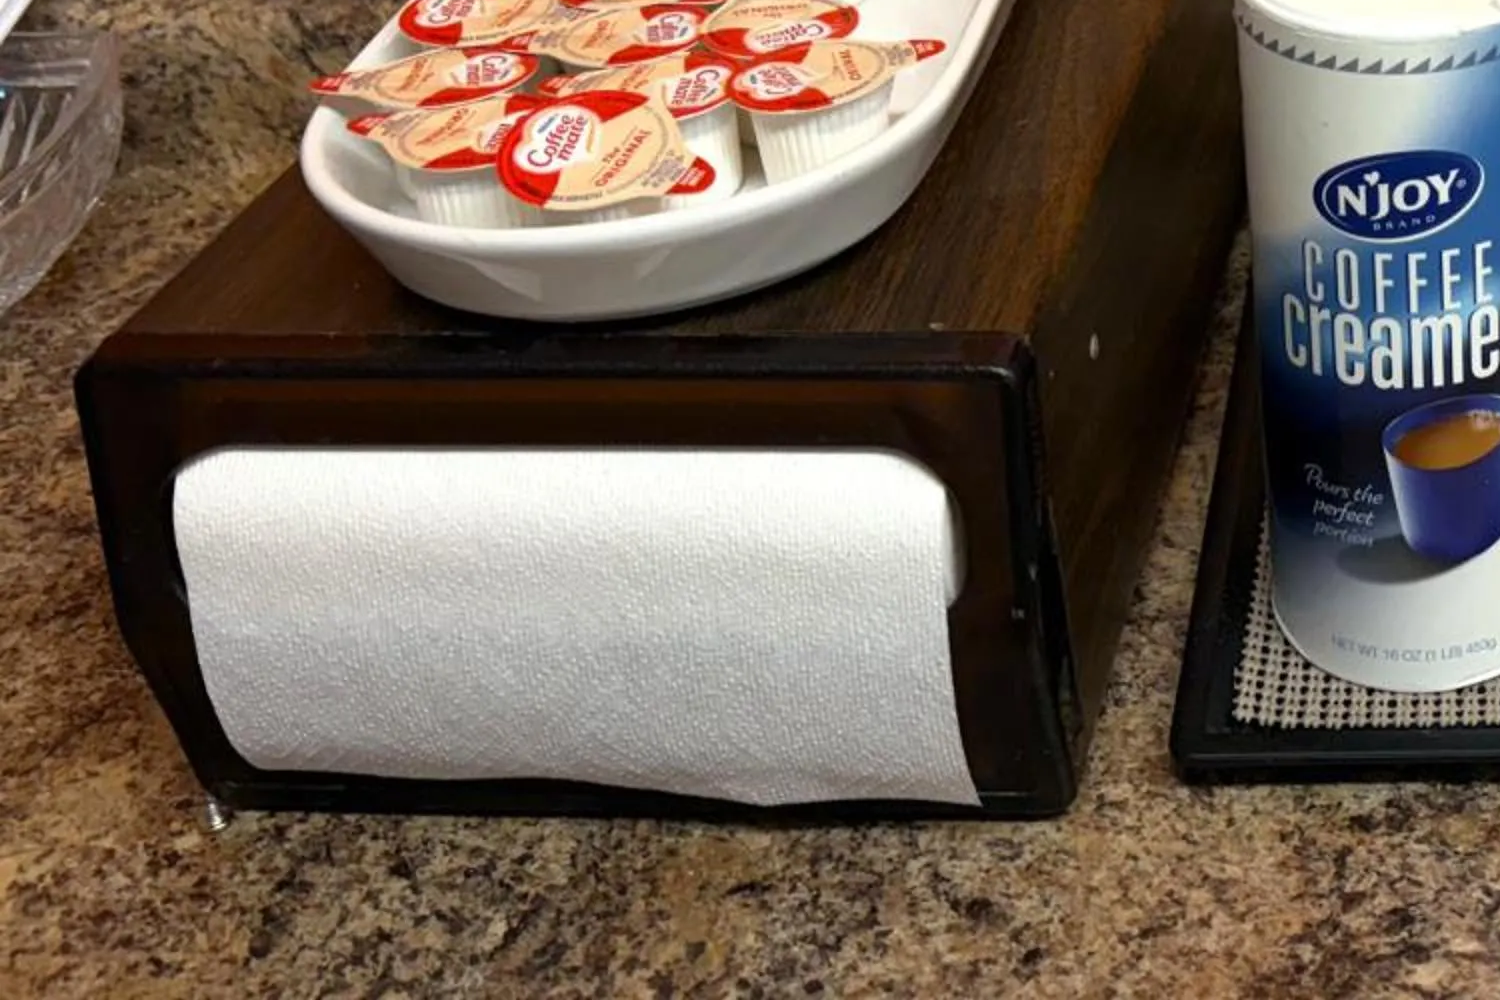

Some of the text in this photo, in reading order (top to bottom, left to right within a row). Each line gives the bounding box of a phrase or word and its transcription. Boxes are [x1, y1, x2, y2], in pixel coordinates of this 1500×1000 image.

[526, 113, 575, 168] Coffee
[557, 113, 589, 162] mate
[594, 128, 653, 188] ORIGINAL
[1372, 215, 1437, 233] BRAND
[1303, 239, 1493, 314] COFFEE
[1303, 462, 1384, 505] Pours the
[1312, 499, 1376, 528] perfect
[1313, 521, 1375, 548] portion
